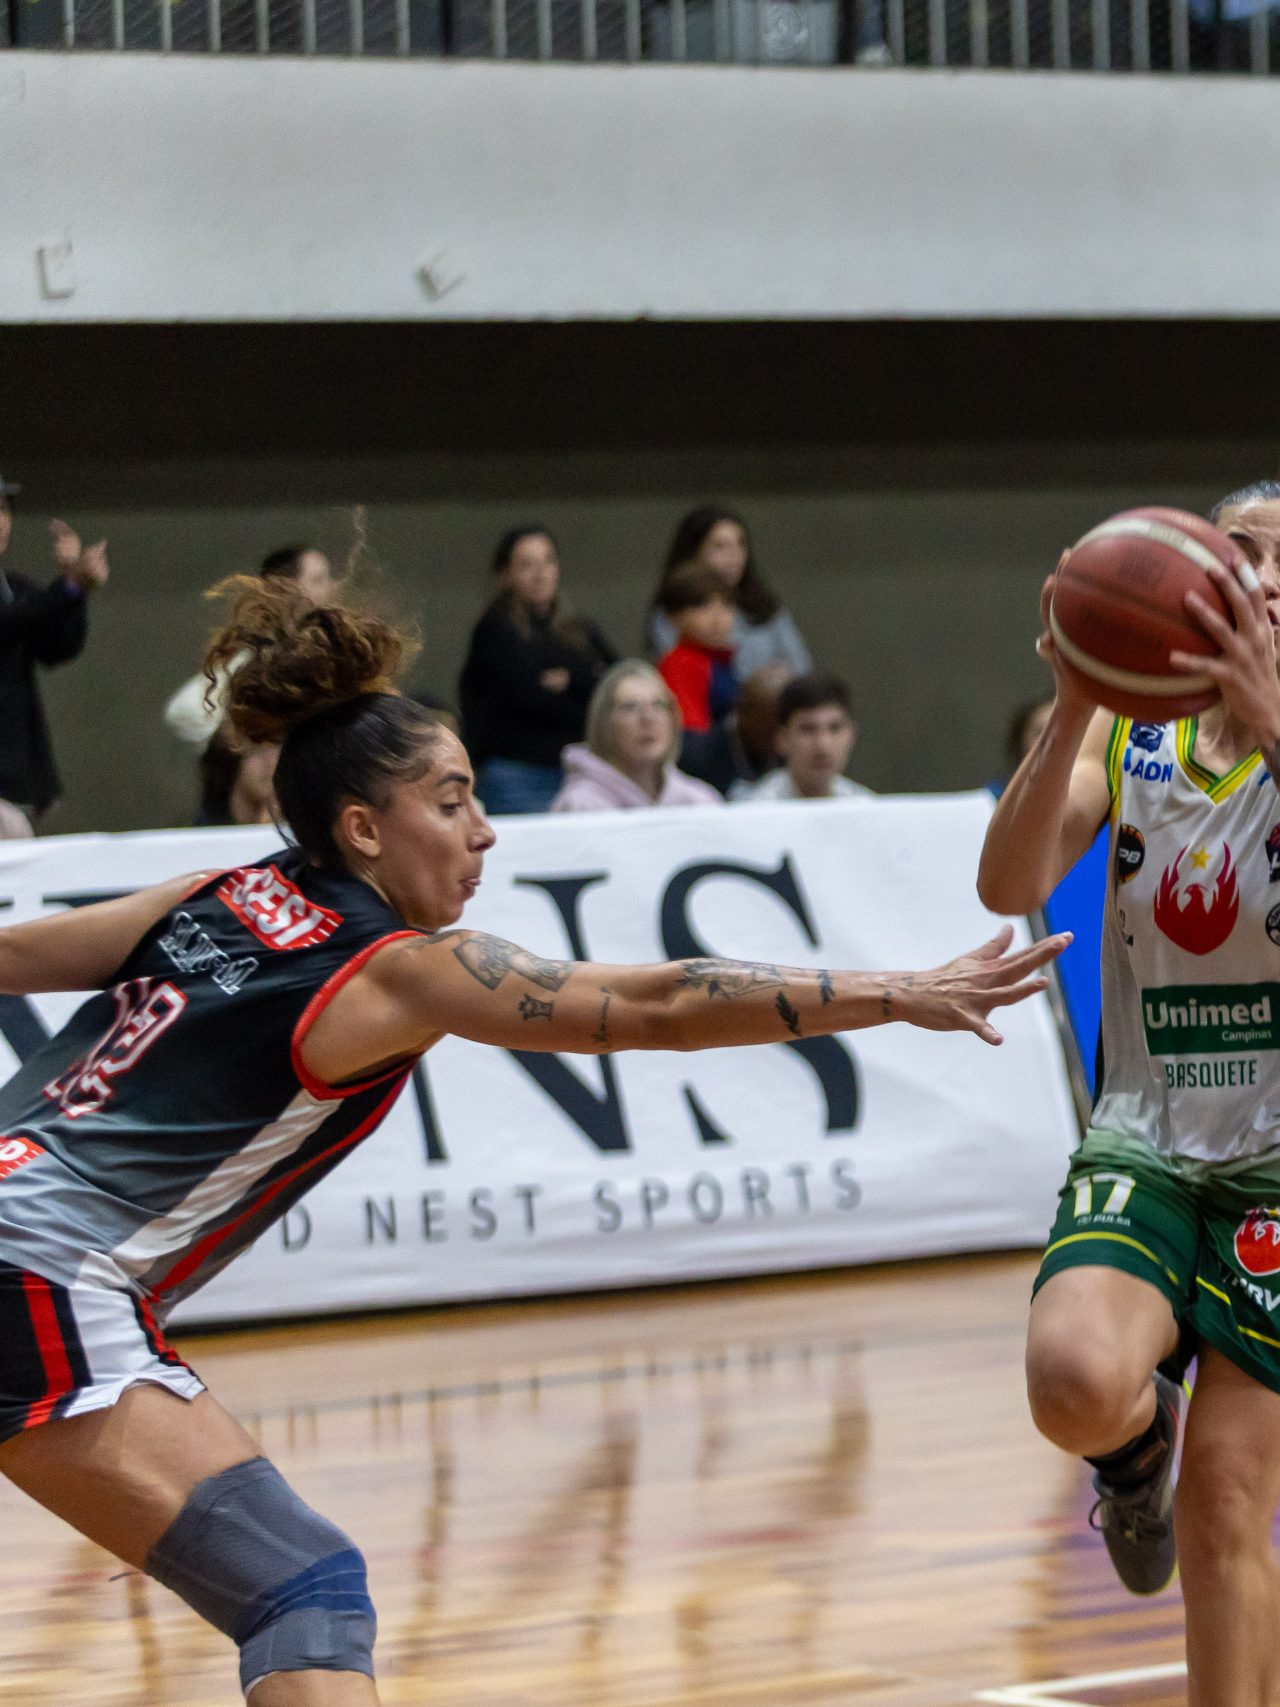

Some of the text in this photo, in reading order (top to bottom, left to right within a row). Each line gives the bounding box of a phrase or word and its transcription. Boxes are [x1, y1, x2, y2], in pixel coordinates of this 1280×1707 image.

[231, 868, 325, 946] SESI
[1145, 995, 1273, 1030] Unimed
[1220, 1028, 1273, 1044] Campinas
[1165, 1058, 1258, 1089] BASQUETE
[364, 1183, 542, 1247] NEST
[592, 1157, 863, 1234] SPORTS
[1073, 1172, 1137, 1219] 17
